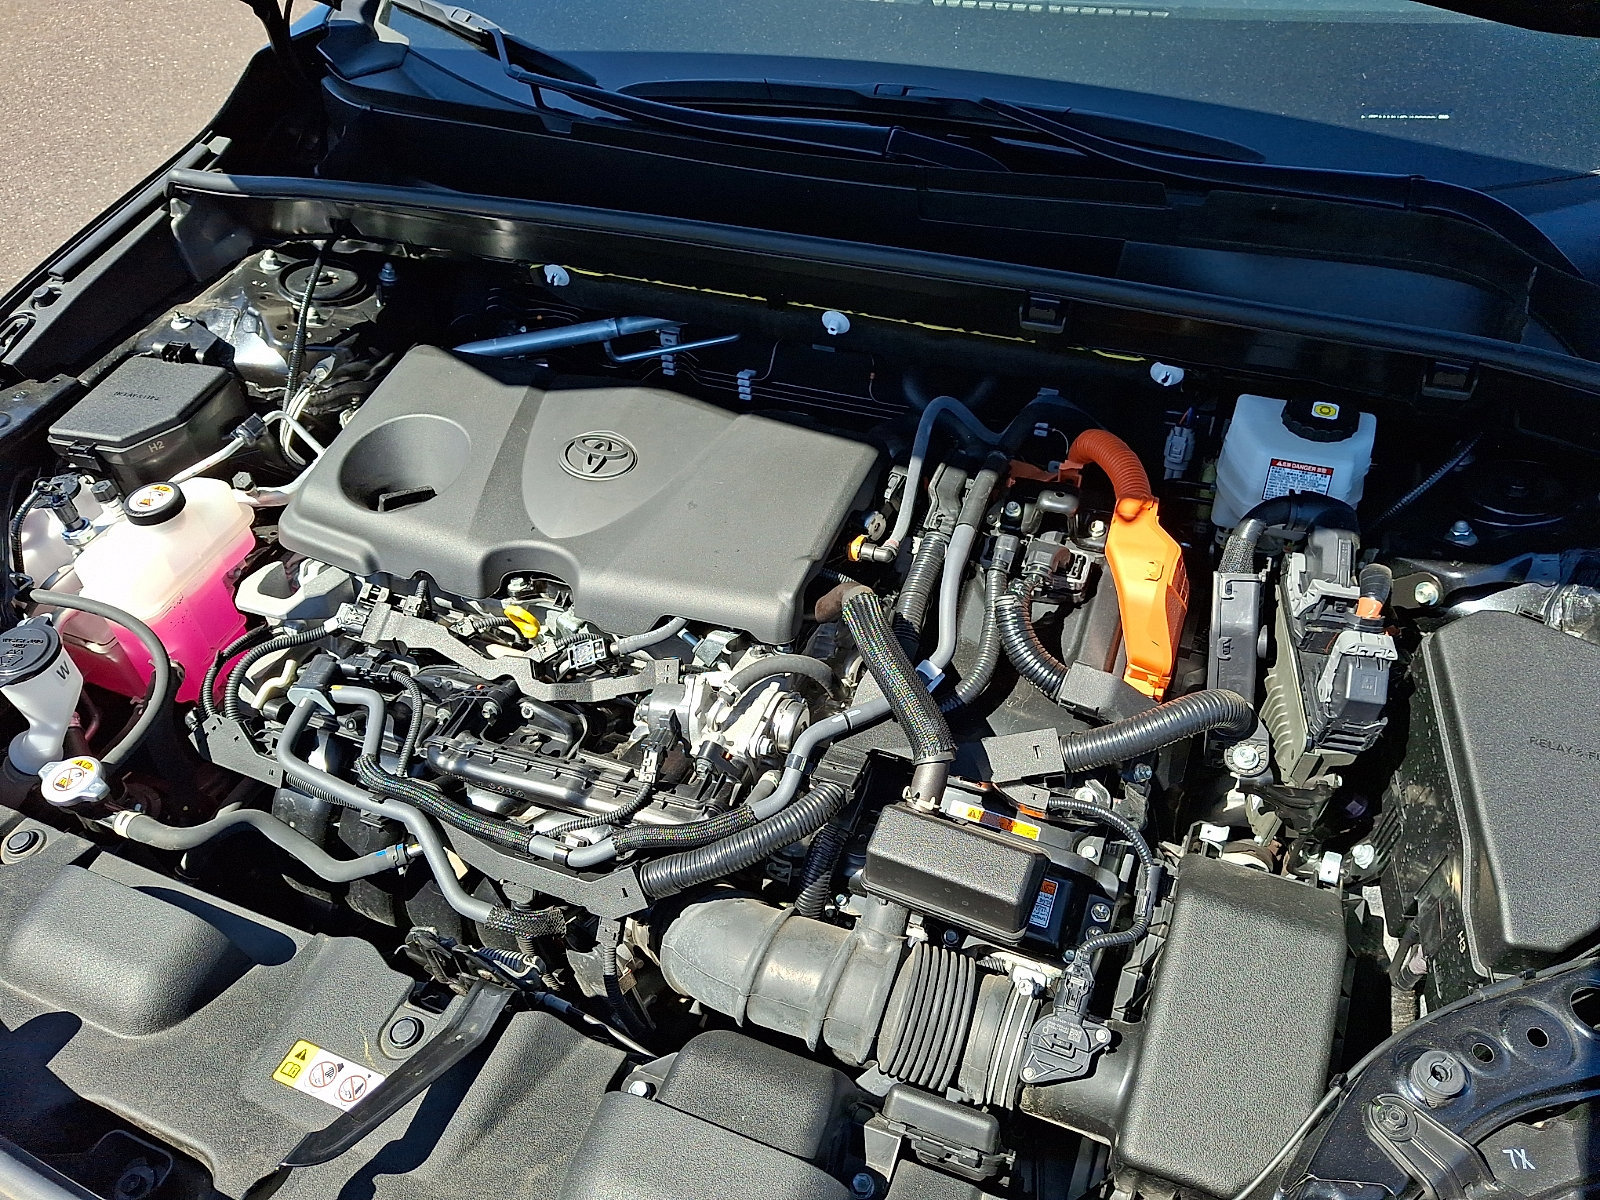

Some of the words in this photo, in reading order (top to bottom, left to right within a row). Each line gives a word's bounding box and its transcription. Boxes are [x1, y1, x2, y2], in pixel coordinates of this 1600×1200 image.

[148, 441, 165, 453] H2
[1291, 463, 1317, 472] DANGER
[56, 660, 70, 680] W
[1529, 736, 1573, 755] RELAY
[1501, 1149, 1536, 1170] 7X
